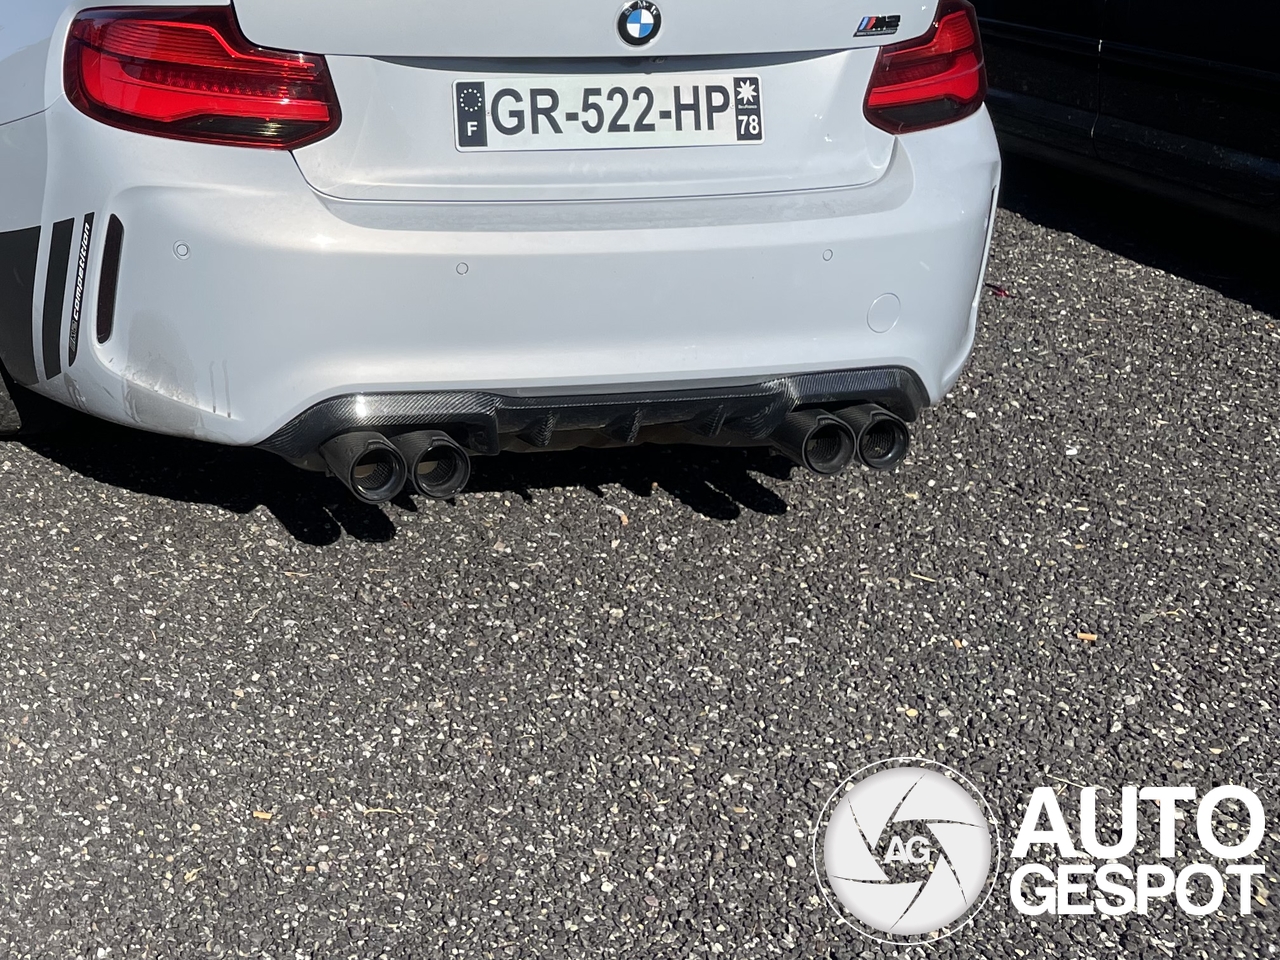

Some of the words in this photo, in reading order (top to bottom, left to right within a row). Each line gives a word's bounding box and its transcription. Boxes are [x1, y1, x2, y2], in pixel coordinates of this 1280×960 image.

[490, 85, 730, 135] GR-522-HP
[466, 121, 478, 137] F
[737, 114, 761, 136] 78
